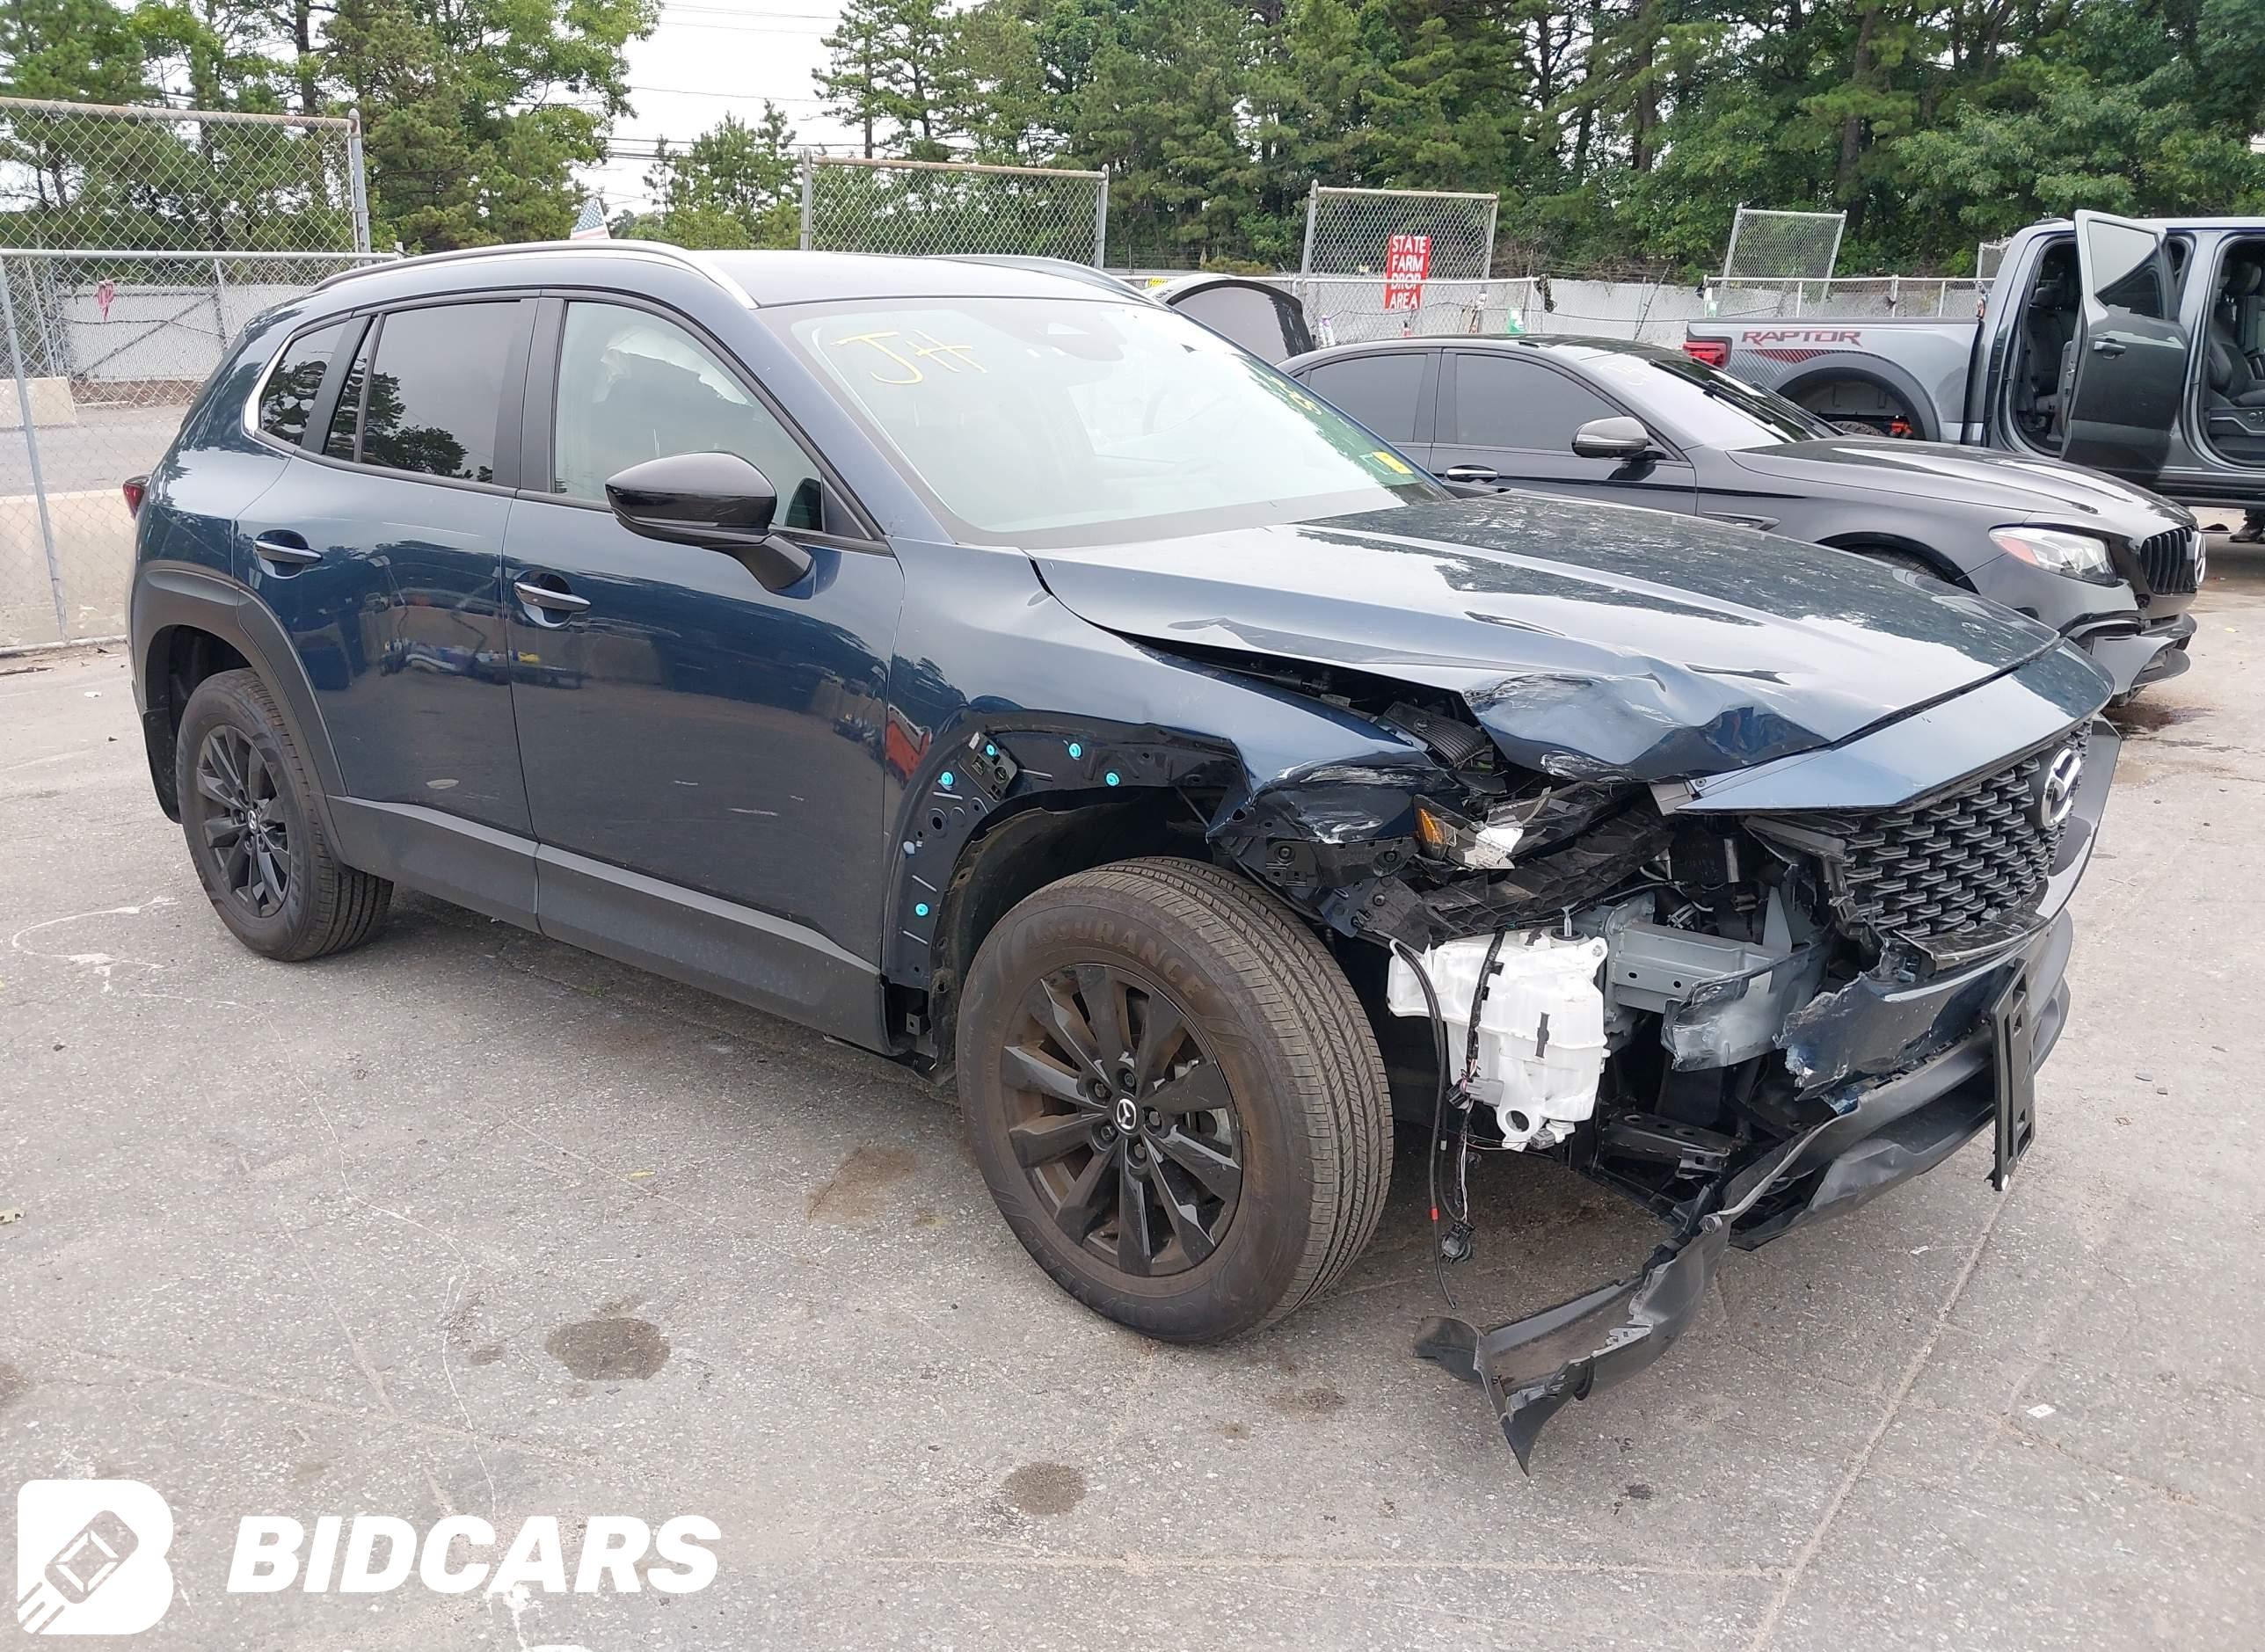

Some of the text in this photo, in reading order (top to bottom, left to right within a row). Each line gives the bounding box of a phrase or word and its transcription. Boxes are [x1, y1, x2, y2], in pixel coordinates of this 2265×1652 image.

[1391, 235, 1428, 254] STATE
[1391, 254, 1424, 273] FARM
[1390, 273, 1422, 290] DROP
[1388, 292, 1418, 309] AREA
[1741, 331, 1862, 347] RAPTOR
[1025, 920, 1205, 1001] ASSURANCE
